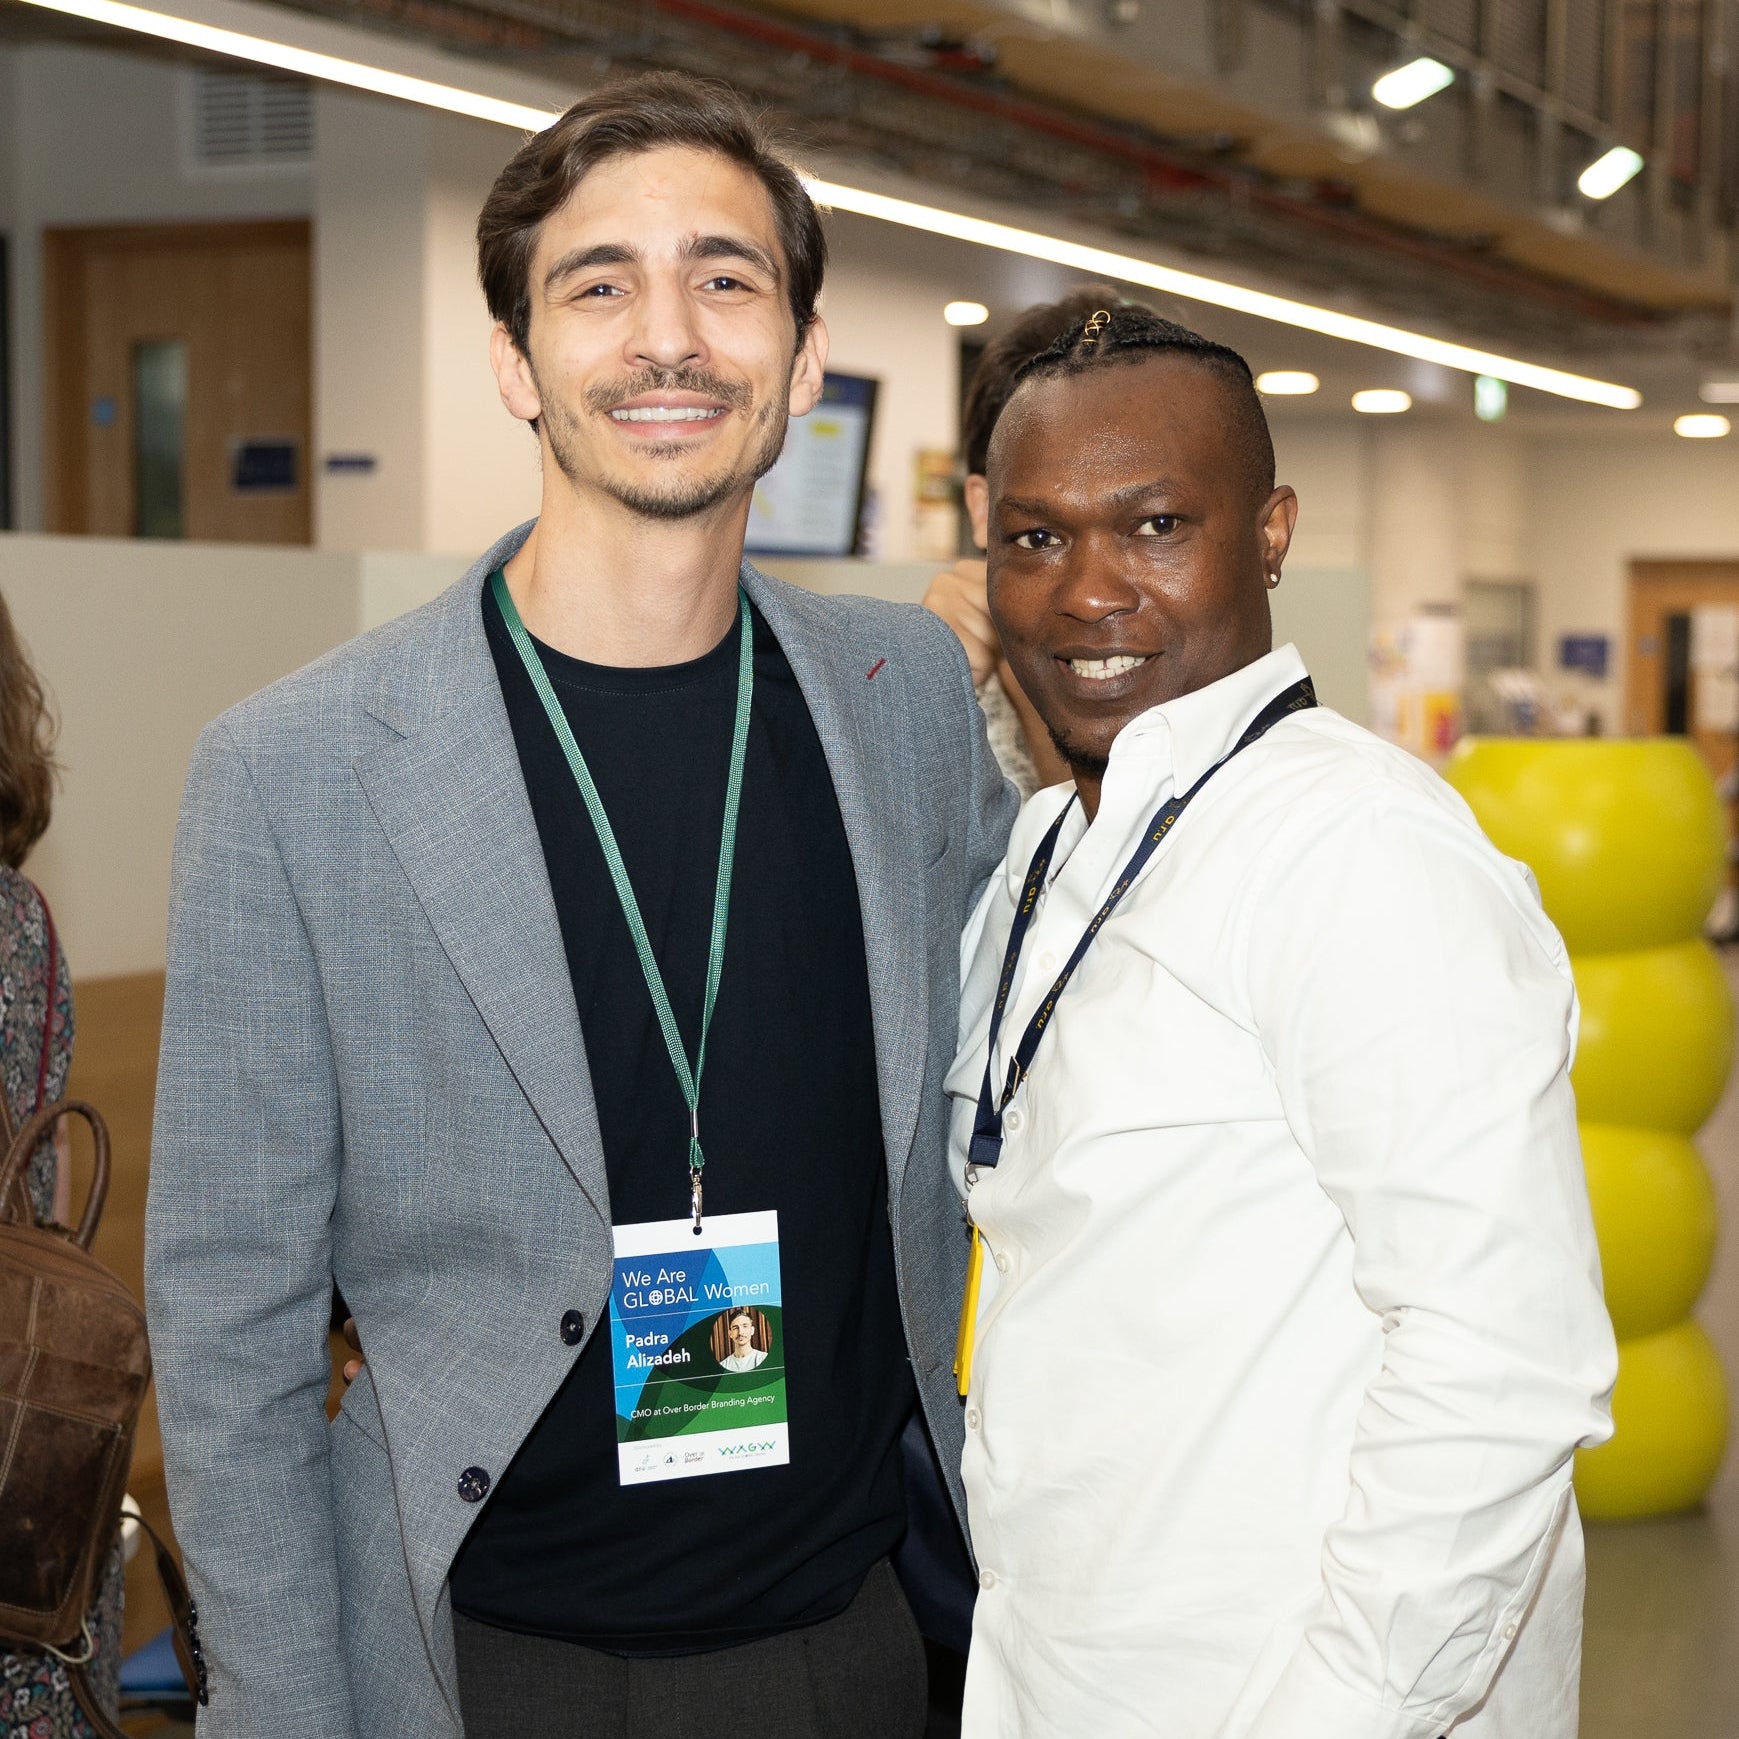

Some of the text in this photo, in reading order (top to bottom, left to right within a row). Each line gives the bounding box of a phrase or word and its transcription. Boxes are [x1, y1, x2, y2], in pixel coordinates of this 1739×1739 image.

[1152, 815, 1175, 841] aru
[1022, 887, 1037, 914] aru
[1036, 1000, 1053, 1029] aru
[622, 1268, 686, 1288] We Are
[623, 1281, 770, 1309] GLOBAL Women
[625, 1331, 669, 1348] Padra
[626, 1347, 691, 1369] Alizadeh
[630, 1409, 652, 1419] CMO
[662, 1405, 682, 1415] Over
[683, 1402, 709, 1412] Border
[711, 1398, 745, 1409] Branding
[747, 1395, 775, 1406] Agency
[718, 1440, 776, 1455] WAGW
